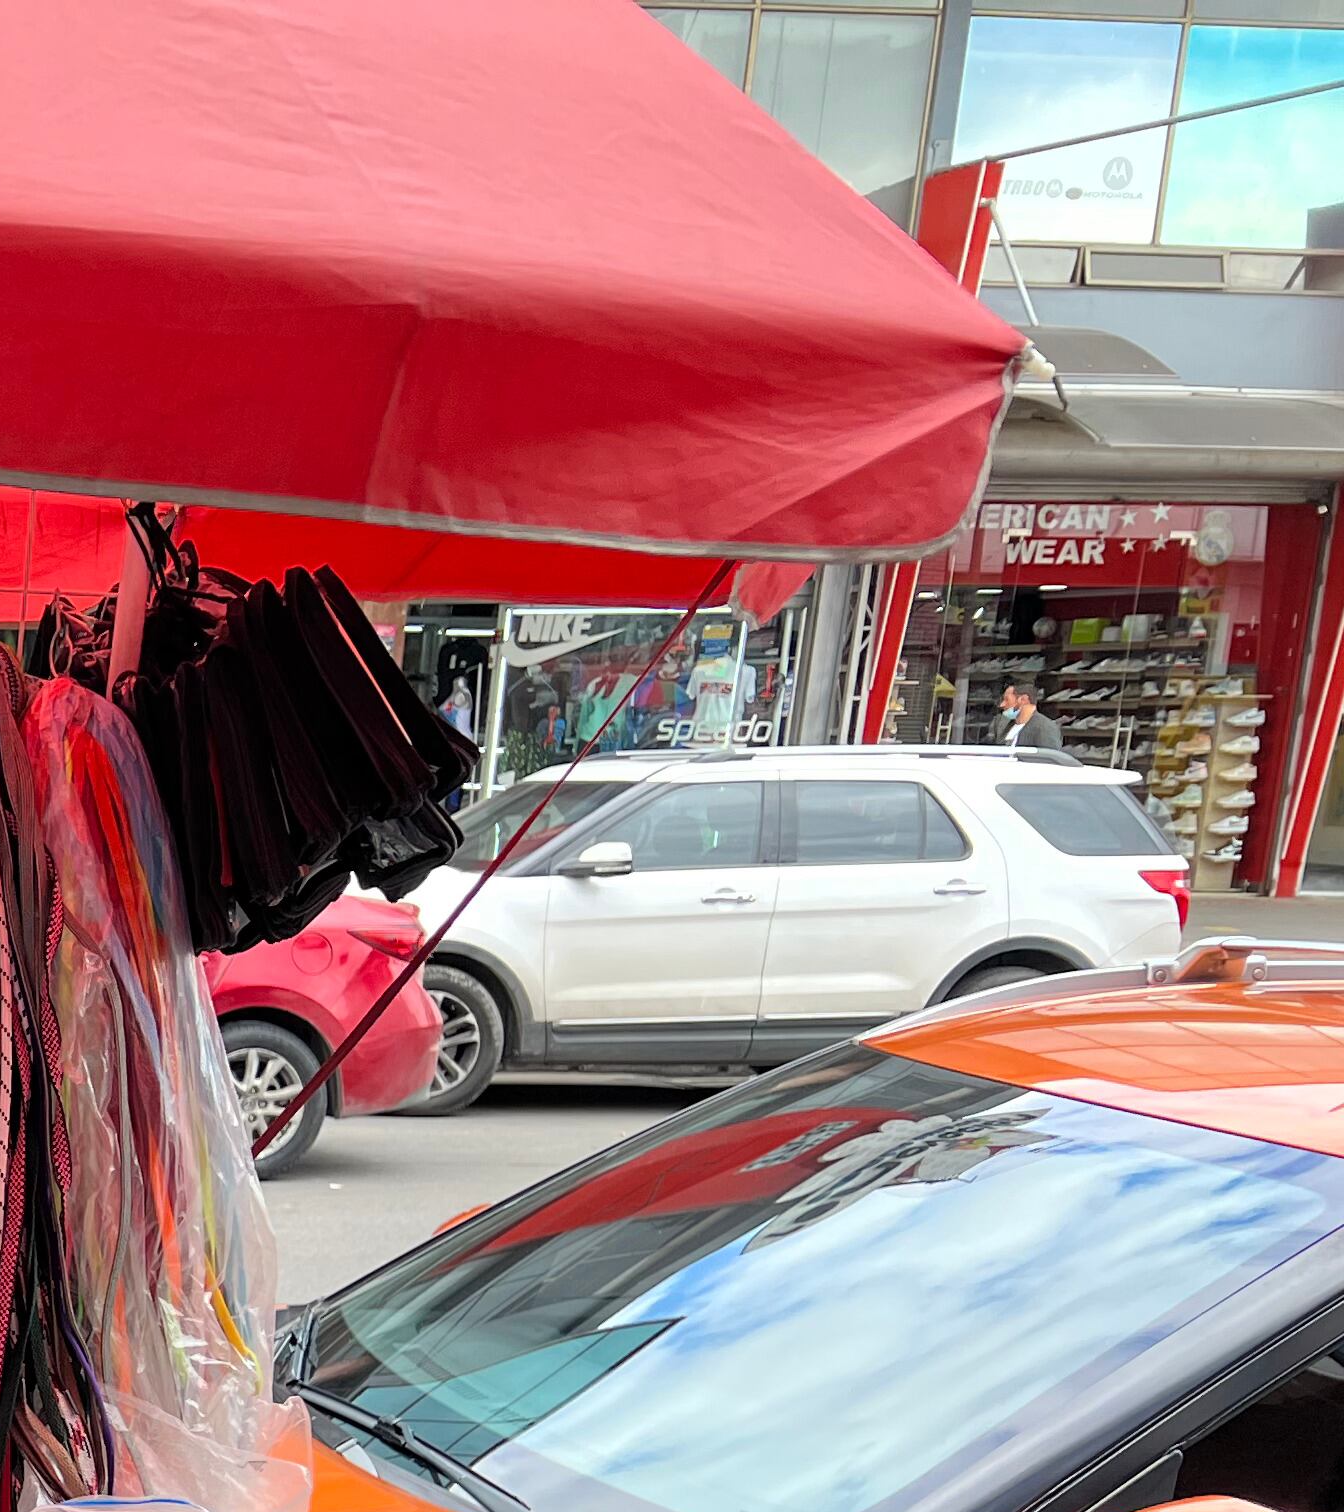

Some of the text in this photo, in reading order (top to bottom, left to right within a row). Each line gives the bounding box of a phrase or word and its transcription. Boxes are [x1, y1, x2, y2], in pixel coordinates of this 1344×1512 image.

[964, 502, 1111, 530] ERICAN
[1006, 539, 1106, 565] WEAR
[517, 614, 594, 643] NIKE
